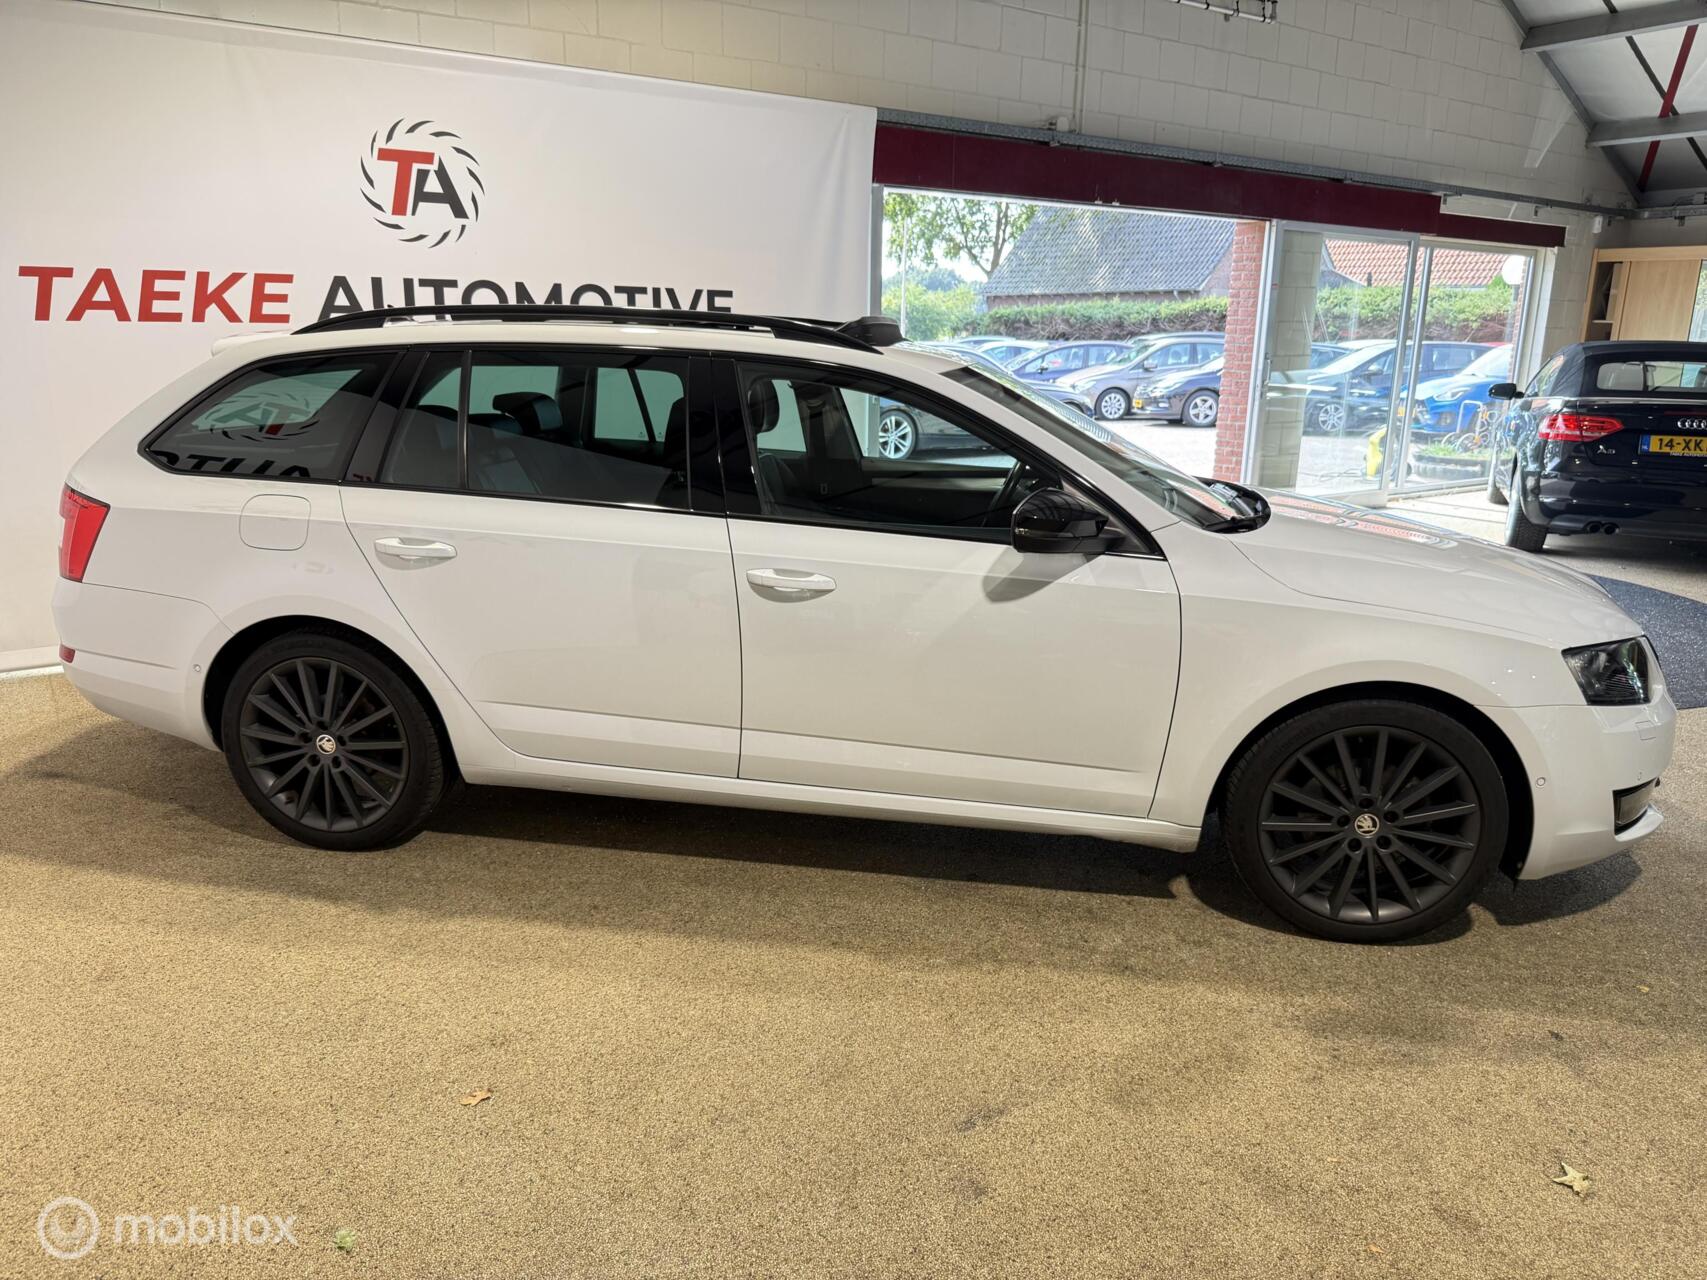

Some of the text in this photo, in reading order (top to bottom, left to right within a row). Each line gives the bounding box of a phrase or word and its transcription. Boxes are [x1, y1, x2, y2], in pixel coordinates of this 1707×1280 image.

[377, 147, 469, 220] TA
[18, 265, 295, 324] TAEKE
[1657, 437, 1707, 452] 14-XK
